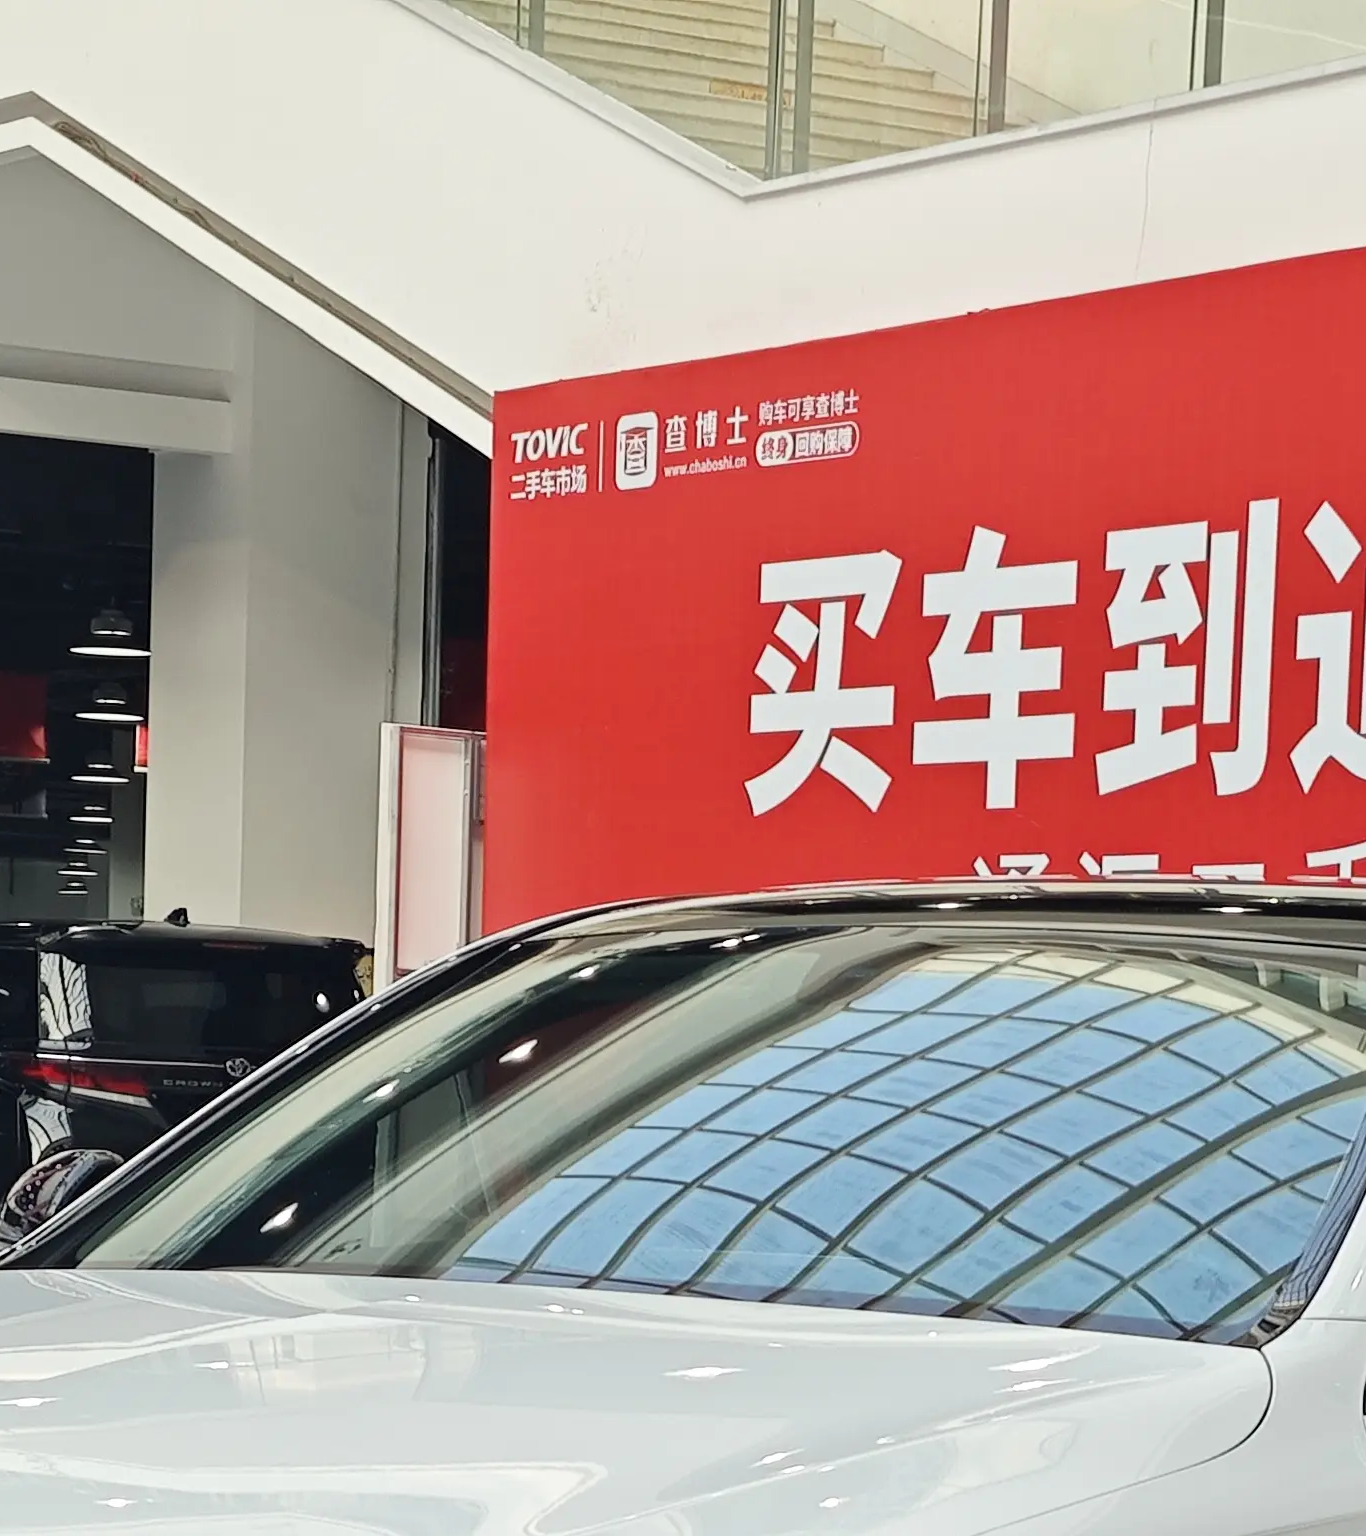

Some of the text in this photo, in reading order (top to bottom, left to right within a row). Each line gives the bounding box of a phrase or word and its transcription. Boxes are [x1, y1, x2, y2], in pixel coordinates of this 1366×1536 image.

[758, 389, 860, 426] 购车可享查博士
[510, 423, 589, 464] TOVIC
[664, 406, 751, 454] 查博士
[760, 426, 854, 462] 终身 回购保障
[509, 465, 588, 501] 二手车市场
[664, 456, 748, 479] www.chaboshi.cn
[163, 1079, 223, 1088] CROWN
